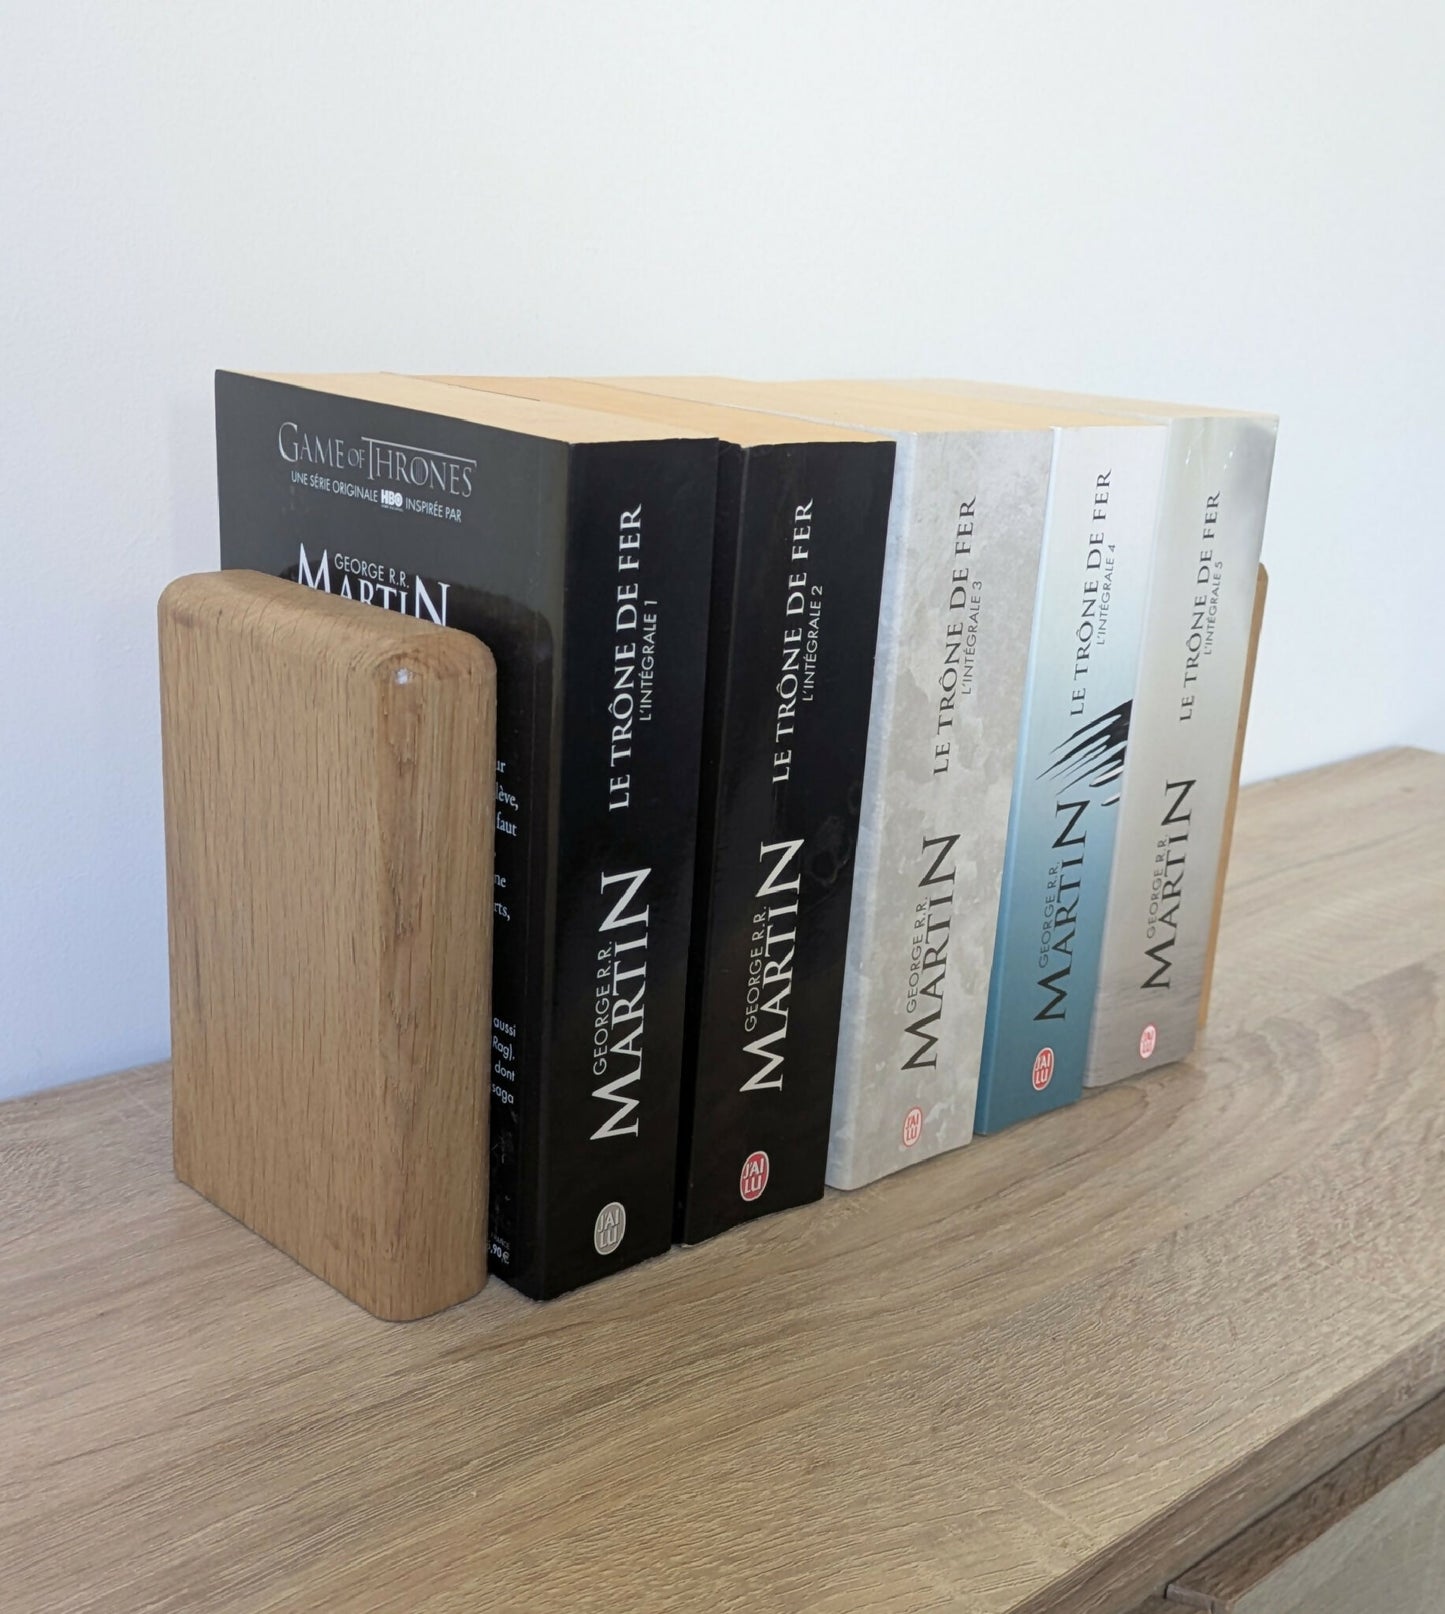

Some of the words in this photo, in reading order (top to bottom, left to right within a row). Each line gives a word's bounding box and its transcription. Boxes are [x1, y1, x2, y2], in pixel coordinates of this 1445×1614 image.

[279, 421, 345, 469] GAME
[347, 447, 366, 469] OF
[361, 435, 477, 498] THRONES
[291, 470, 309, 486] UNE
[309, 473, 331, 492] SÉRIE
[332, 480, 379, 503] ORIGINALE
[381, 489, 403, 508] HBO
[405, 497, 443, 518] INSPIRÉE
[445, 506, 462, 523] PAR
[1092, 468, 1112, 521] FER
[1203, 490, 1220, 540] FER
[618, 503, 642, 572] FER
[792, 498, 814, 561] FER
[955, 496, 976, 556] FER
[1086, 532, 1104, 570] DE
[298, 542, 451, 627] MARTIN
[334, 553, 385, 582] GEORGE
[389, 568, 410, 589] R.R.
[786, 572, 807, 617] DE
[950, 568, 969, 611] DE
[1096, 557, 1115, 645] L'INTÉGRALE
[1108, 544, 1116, 552] 4
[1197, 550, 1212, 583] DE
[616, 583, 638, 632] DE
[1074, 580, 1099, 680] TRÔNE
[1204, 573, 1222, 655] L'INTÉGRALE
[1216, 561, 1223, 569] 5
[802, 602, 822, 701] L'INTÉGRALE
[812, 585, 822, 595] 2
[962, 596, 980, 694] L'INTÉGRALE
[973, 581, 982, 590] 3
[1183, 594, 1207, 688] TRÔNE
[639, 613, 656, 721] L'INTÉGRALE
[776, 628, 802, 742] TRÔNE
[937, 622, 964, 735] TRÔNE
[608, 643, 636, 767] TRÔNE
[1070, 687, 1086, 716] LE
[1180, 695, 1195, 722] LE
[772, 749, 792, 784] LE
[933, 742, 950, 776] LE
[609, 774, 630, 812] LE
[497, 811, 517, 836] faut
[914, 896, 928, 929] R.R.
[1033, 800, 1090, 1022] MARTIN
[1140, 779, 1196, 990] MARTIN
[1146, 870, 1163, 939] GEORGE
[1155, 834, 1168, 862] R.R.
[752, 906, 767, 941] R.R.
[1038, 896, 1056, 968] GEORGE
[1048, 861, 1060, 888] R.R.
[598, 941, 614, 978] R.R.
[739, 838, 805, 1092] MARTIN
[900, 834, 962, 1071] MARTIN
[906, 935, 924, 1013] GEORGE
[590, 868, 652, 1141] MARTIN
[744, 946, 763, 1032] GEORGE
[493, 1017, 516, 1037] aussi
[593, 984, 610, 1076] GEORGE
[491, 1083, 514, 1105] saga
[494, 1059, 516, 1081] dont
[1035, 1068, 1049, 1084] LU
[743, 1158, 764, 1179] J'AI
[745, 1174, 762, 1194] LU
[600, 1224, 617, 1249] LU
